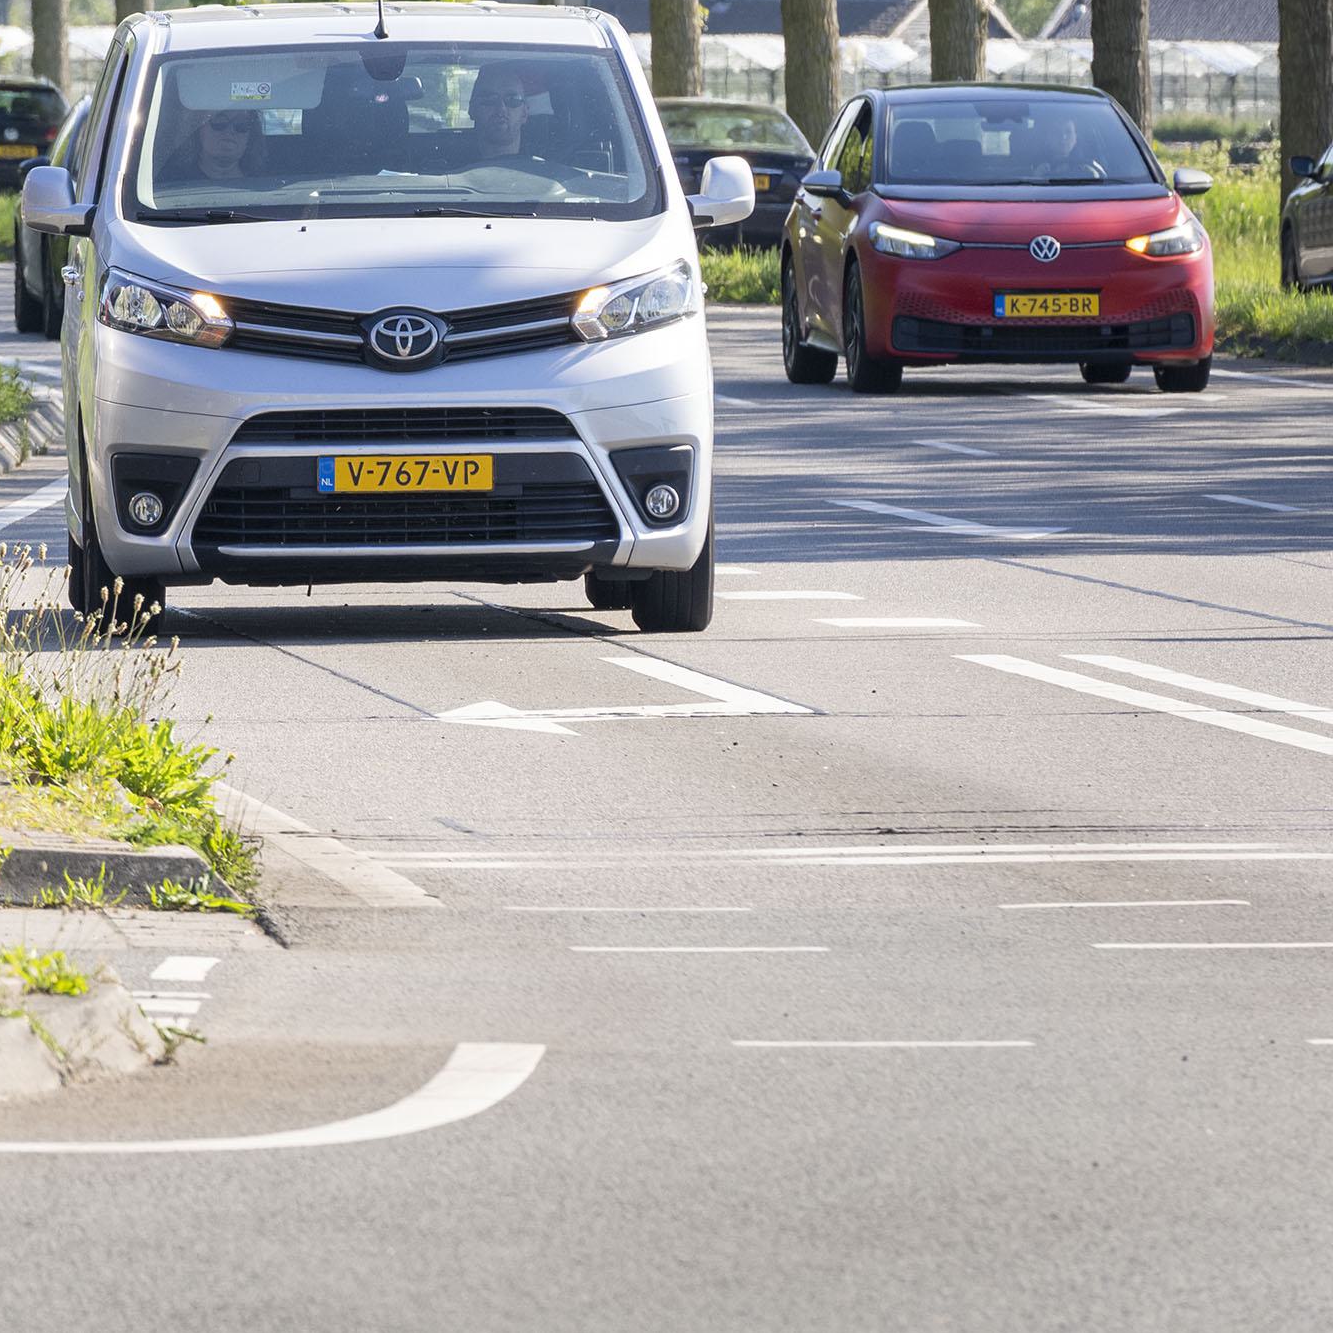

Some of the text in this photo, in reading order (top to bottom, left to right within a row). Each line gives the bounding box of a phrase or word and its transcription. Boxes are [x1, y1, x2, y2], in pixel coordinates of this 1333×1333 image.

[1010, 298, 1092, 313] K-745-BR
[321, 460, 480, 486] NL V-767-VP
